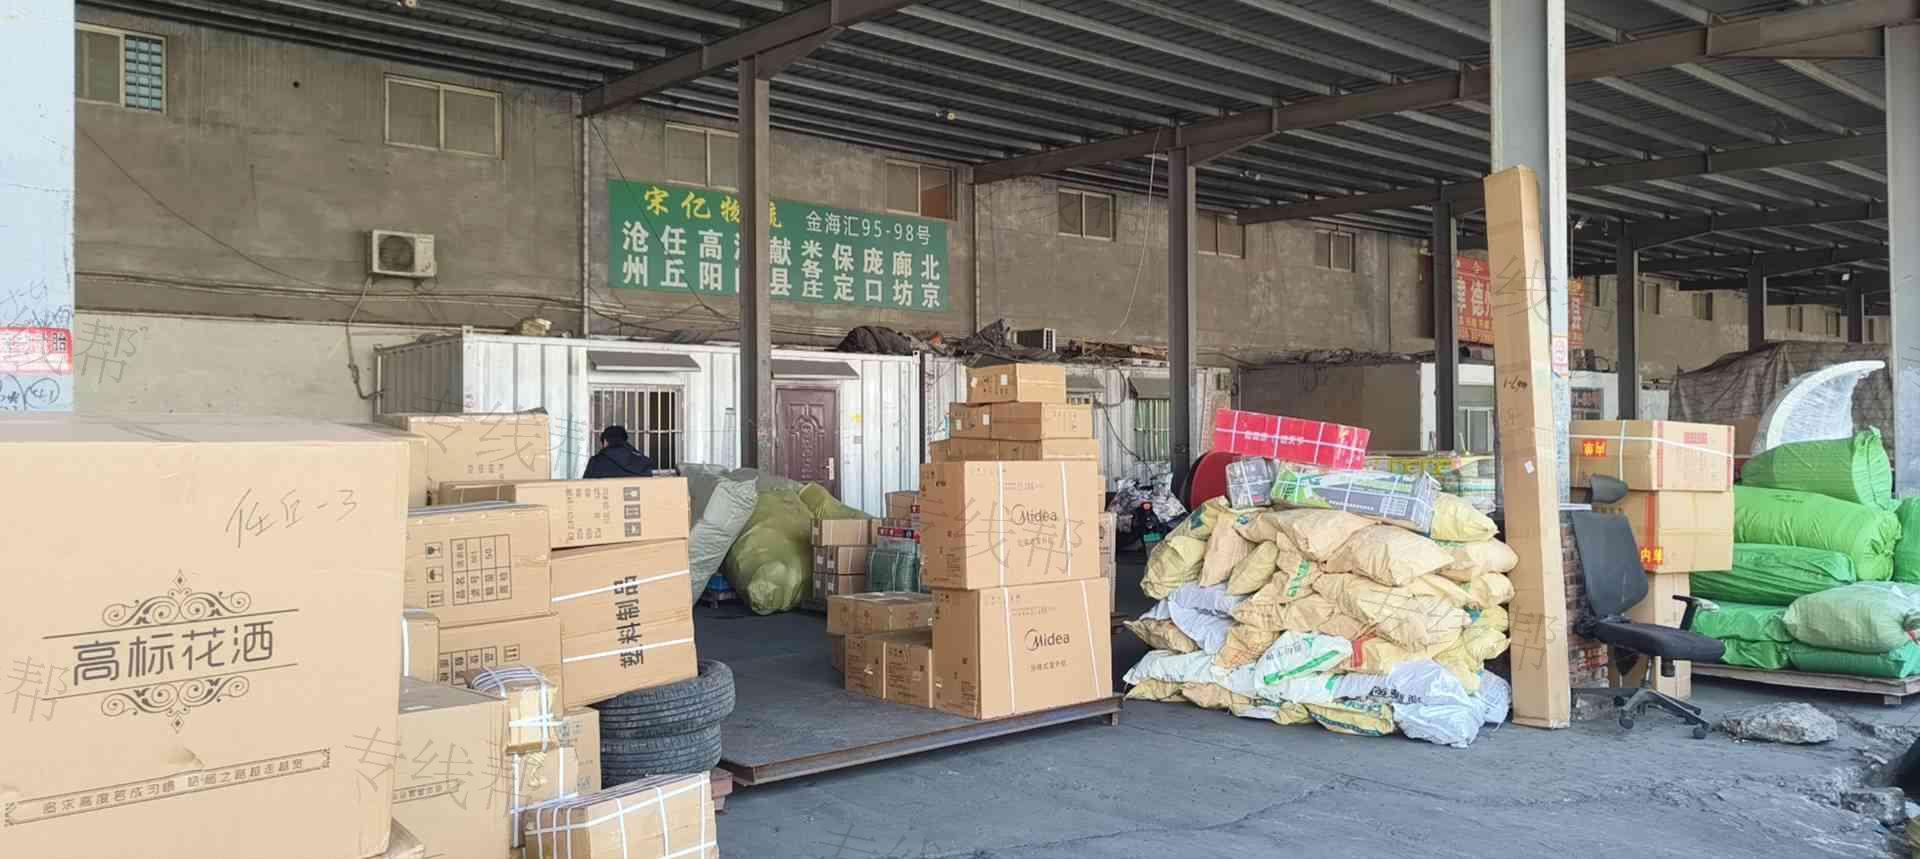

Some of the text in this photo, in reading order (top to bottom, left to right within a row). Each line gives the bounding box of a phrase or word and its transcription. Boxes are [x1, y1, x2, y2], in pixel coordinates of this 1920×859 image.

[622, 220, 649, 287] 沧州
[660, 224, 688, 289] 任丘
[805, 210, 932, 246] 金海汇95-98号
[697, 228, 724, 291] 高阳
[768, 236, 793, 297] 献县
[832, 243, 855, 303] 保定
[892, 252, 913, 308] 廊坊
[921, 254, 942, 309] 北京
[1011, 504, 1057, 525] Midea
[613, 575, 643, 670] 塑料制品
[1025, 629, 1070, 651] Midea
[73, 620, 274, 686] 高标花洒
